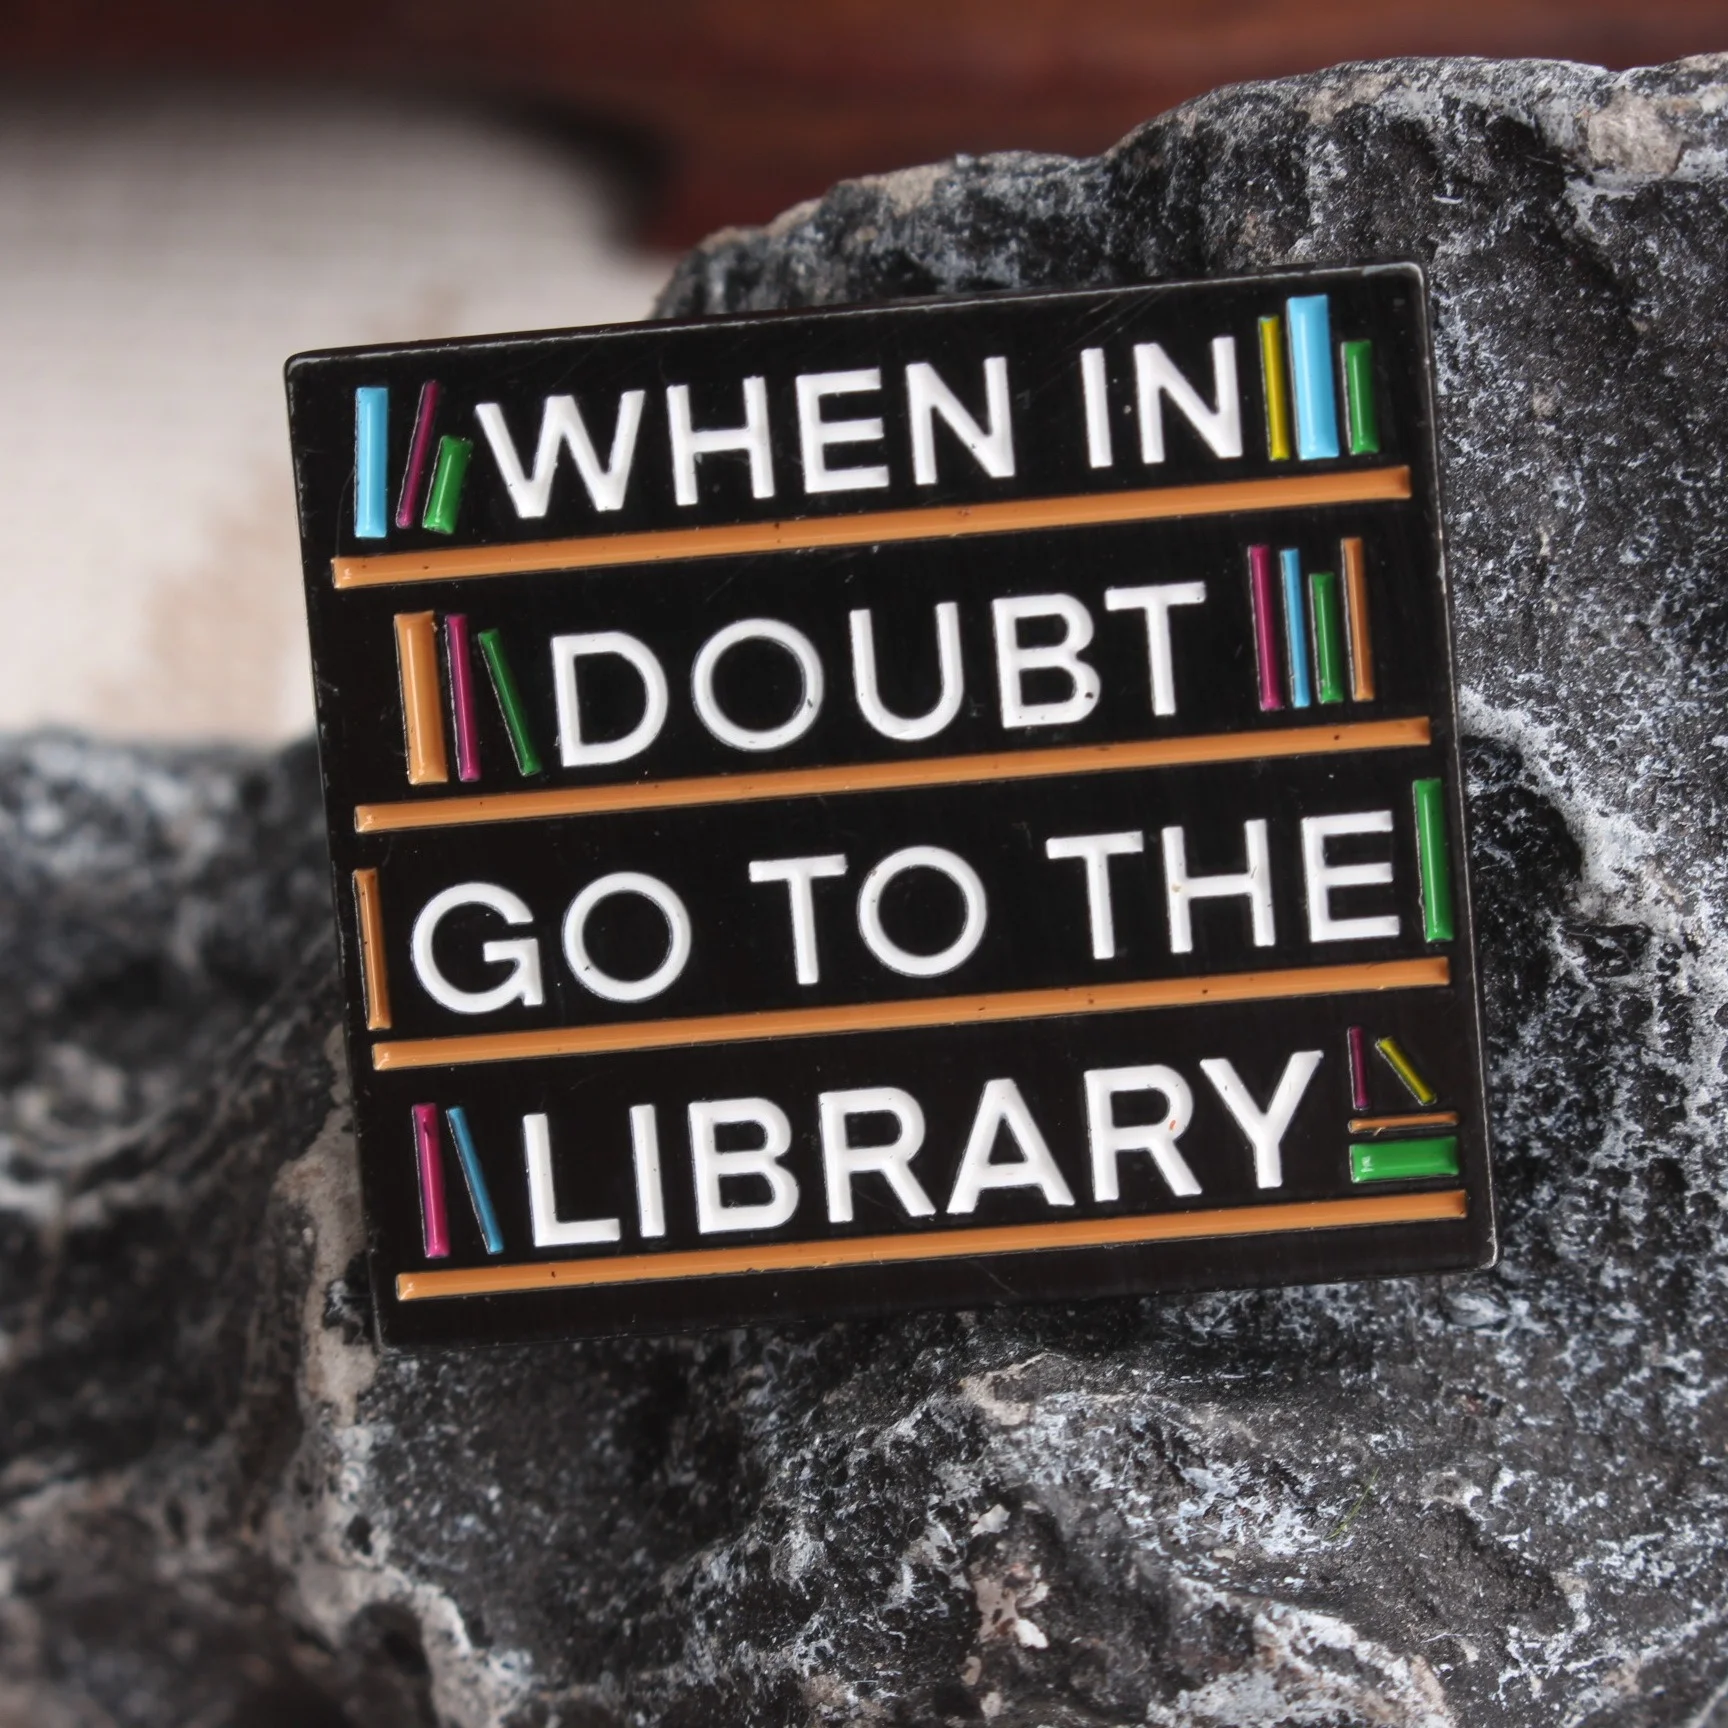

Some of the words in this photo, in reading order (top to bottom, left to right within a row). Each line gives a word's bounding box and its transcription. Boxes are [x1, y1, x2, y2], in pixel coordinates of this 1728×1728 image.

[474, 356, 1015, 519] WHEN
[1080, 336, 1243, 469] IN
[550, 581, 1207, 768] DOUBT
[410, 872, 691, 1014] GO
[748, 845, 987, 985] TO
[1045, 810, 1400, 960] THE
[522, 1050, 1324, 1248] LIBRARY
